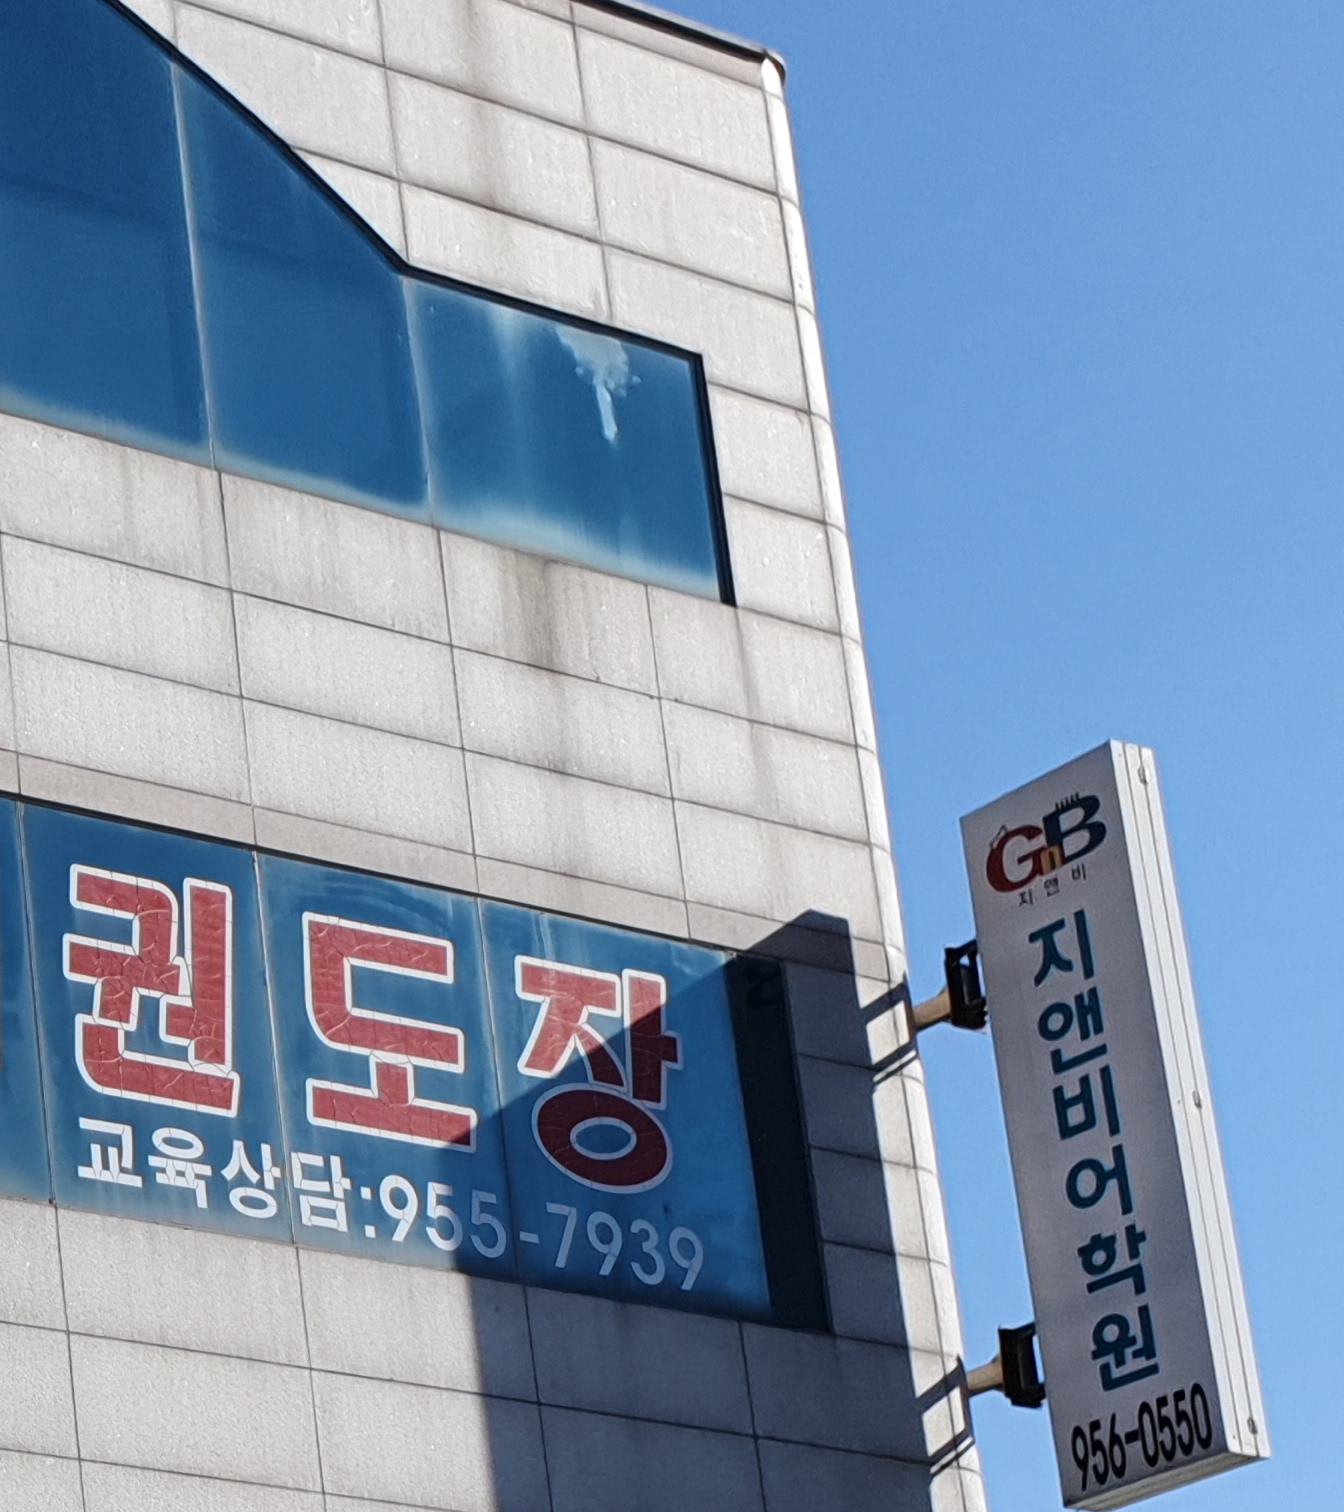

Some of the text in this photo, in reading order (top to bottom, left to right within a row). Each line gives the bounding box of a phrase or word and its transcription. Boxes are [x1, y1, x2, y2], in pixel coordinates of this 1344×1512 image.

[986, 791, 1107, 893] GnB
[1028, 908, 1160, 1392] 지앤비어학원
[1070, 1383, 1212, 1492] 956-0550
